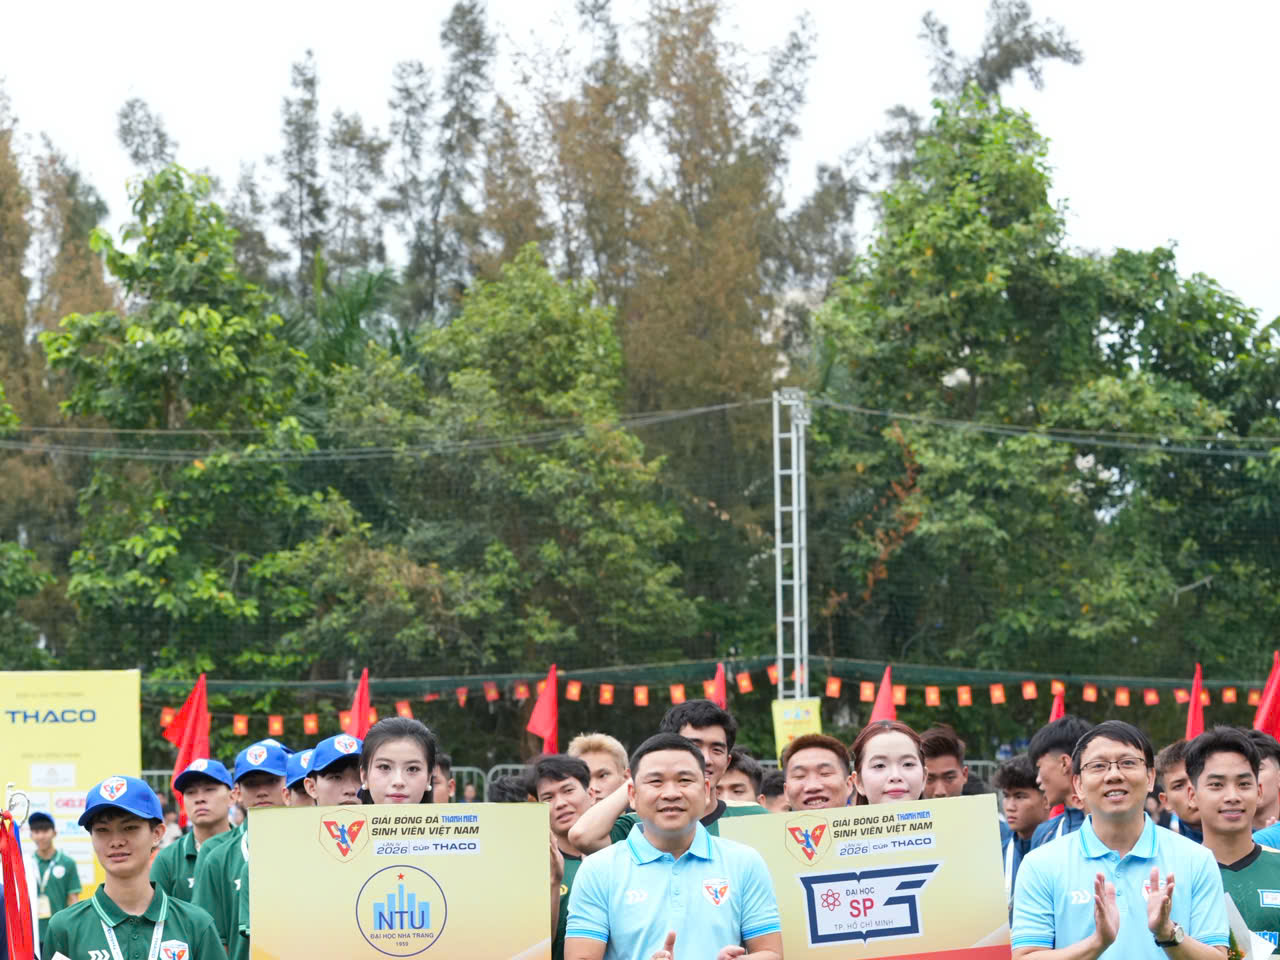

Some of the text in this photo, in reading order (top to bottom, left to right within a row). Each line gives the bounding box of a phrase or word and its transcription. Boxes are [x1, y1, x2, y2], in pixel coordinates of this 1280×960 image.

[5, 709, 96, 724] THACO
[372, 815, 391, 825] GIẢI
[394, 814, 422, 824] BÓNG
[425, 814, 439, 824] ĐÁ
[853, 815, 879, 826] BÓNG
[882, 814, 895, 824] ĐÁ
[372, 825, 479, 836] SINH VIÊN VIỆT NAM
[833, 821, 933, 839] SINH VIÊN VIỆT NAM
[376, 847, 408, 855] 2026
[433, 843, 477, 851] THACO
[840, 846, 868, 856] 2026
[891, 838, 932, 848] THACO
[846, 886, 875, 897] ĐẠI HỌC
[850, 898, 874, 918] SP
[379, 911, 425, 930] NTU
[834, 923, 845, 931] TP.
[874, 919, 894, 927] MINH
